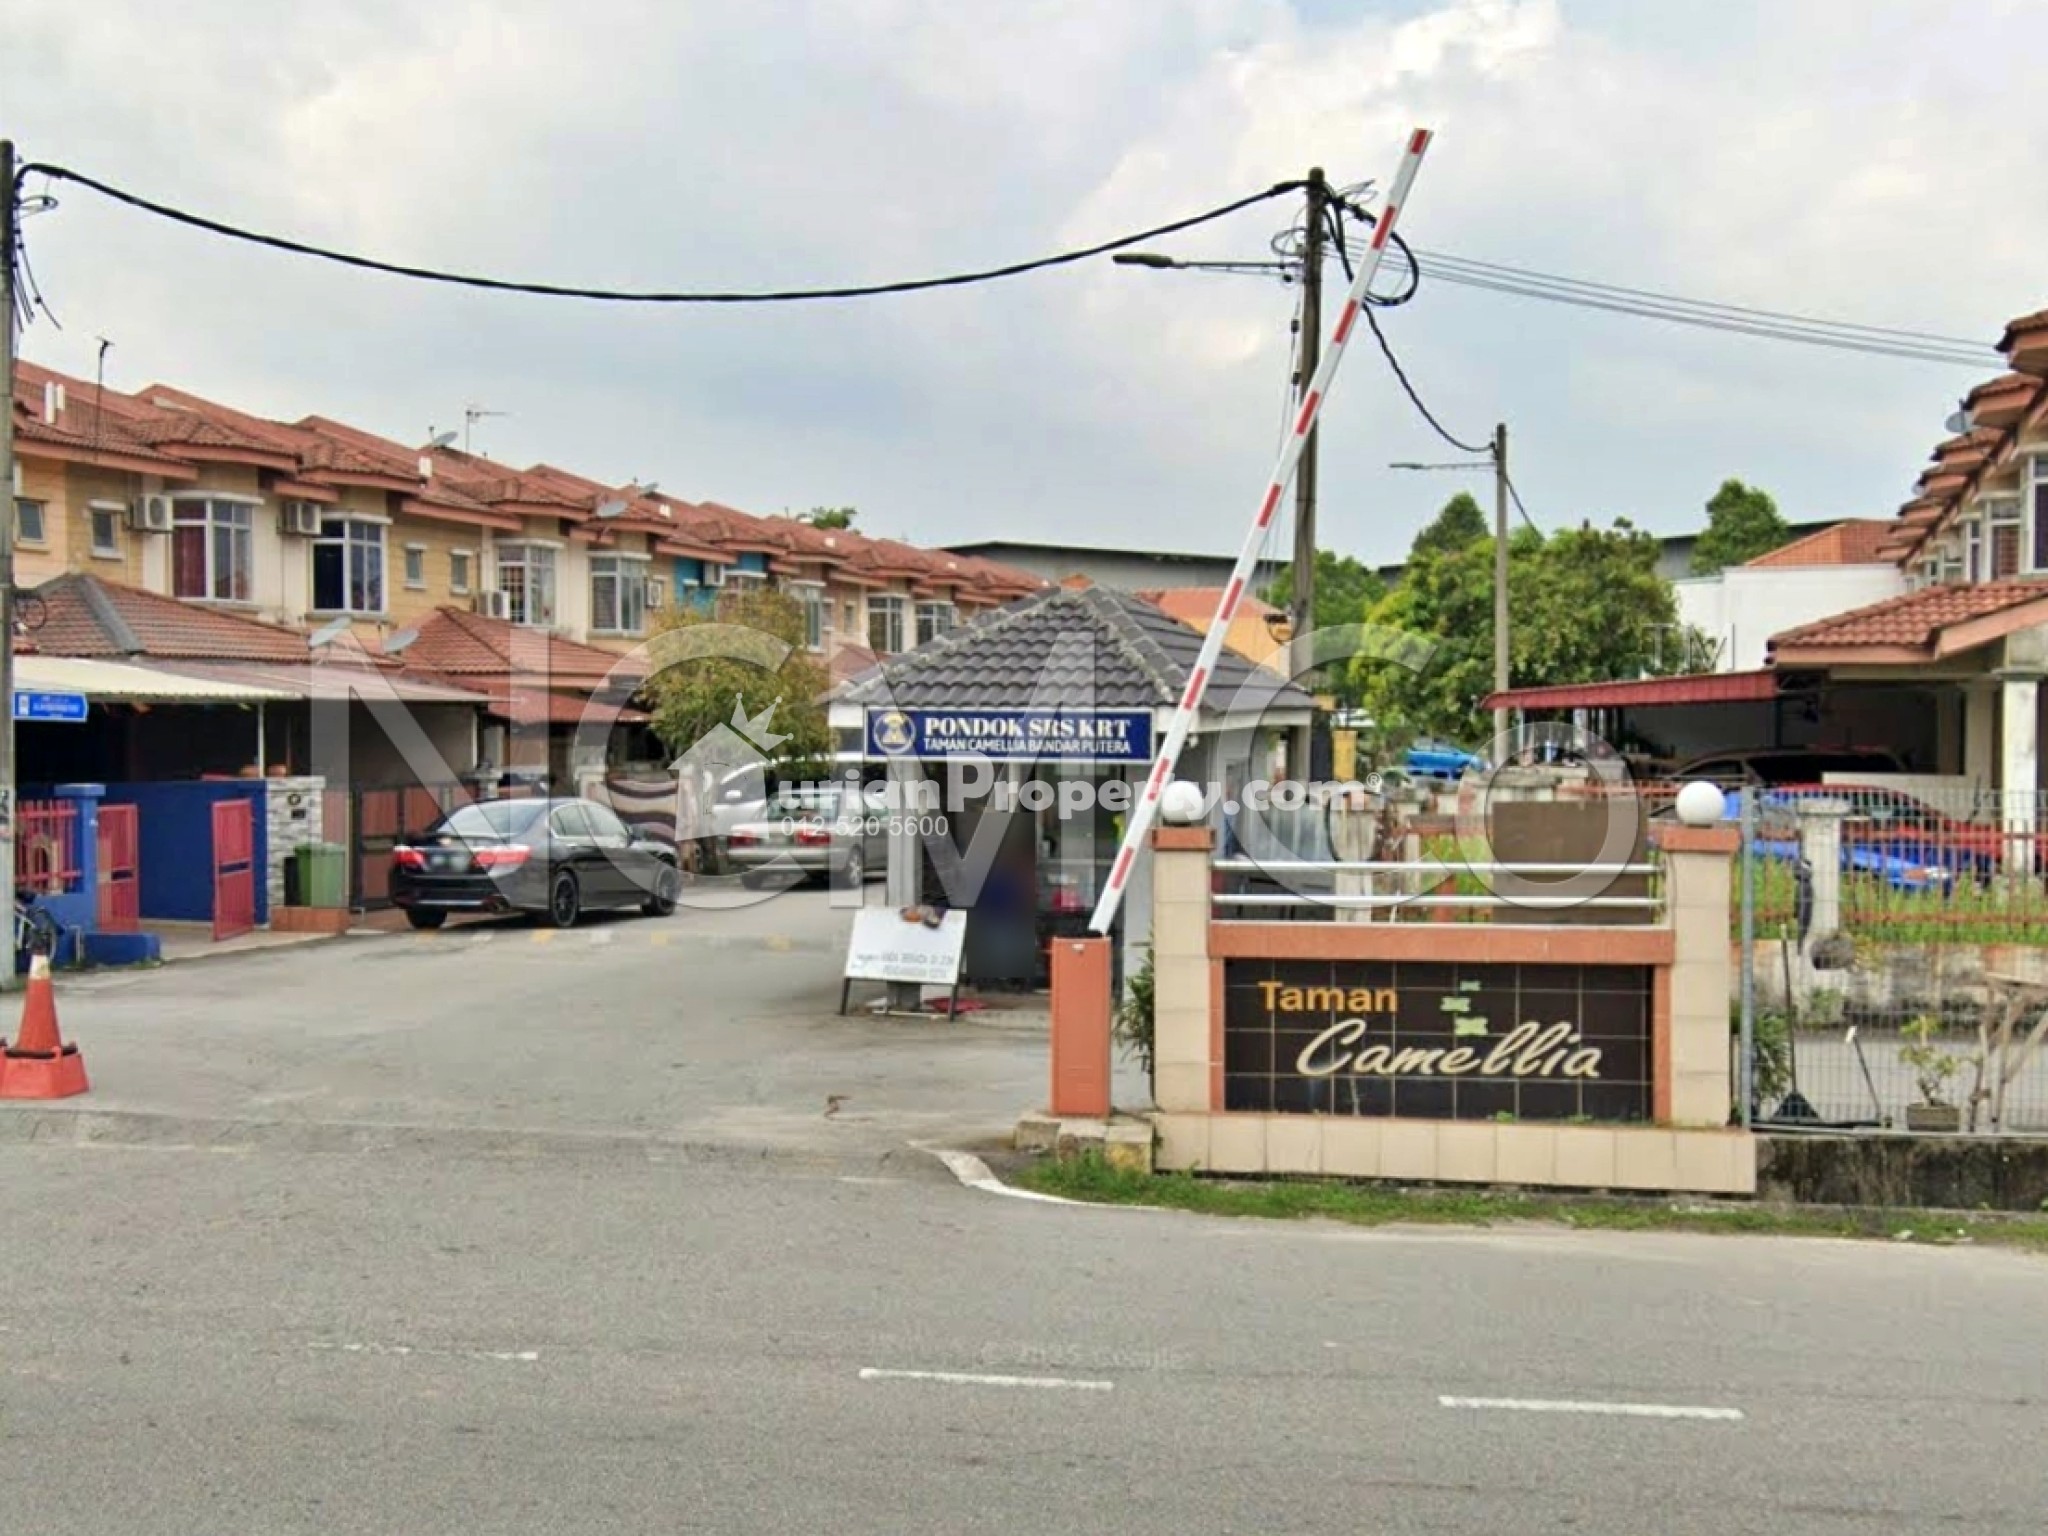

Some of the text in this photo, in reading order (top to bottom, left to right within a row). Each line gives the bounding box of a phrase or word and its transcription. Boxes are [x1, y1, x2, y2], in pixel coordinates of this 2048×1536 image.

[924, 717, 1025, 737] PONDOK
[1079, 719, 1131, 738] KRT
[924, 738, 1131, 754] TAMAN CAMELLIA BANDAR PUTERA
[1258, 980, 1398, 1012] Taman
[1296, 1017, 1601, 1077] Camellia
